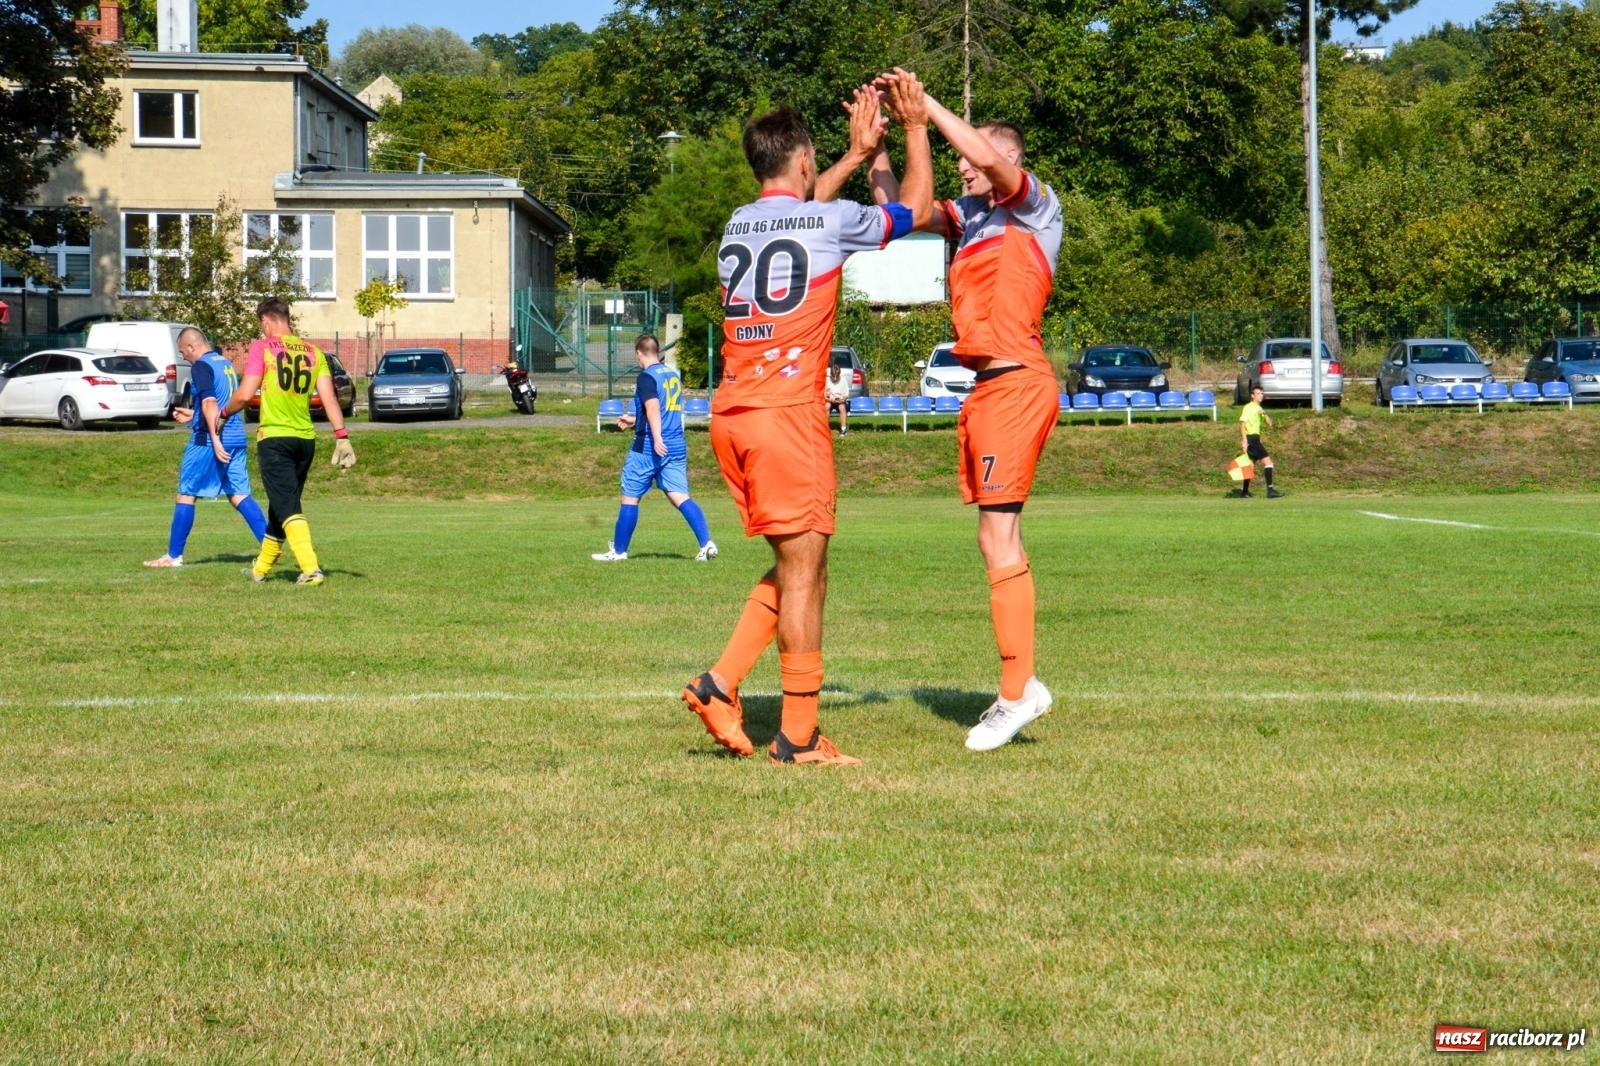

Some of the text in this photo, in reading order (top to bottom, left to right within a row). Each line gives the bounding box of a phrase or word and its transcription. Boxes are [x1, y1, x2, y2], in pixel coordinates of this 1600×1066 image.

[752, 220, 768, 234] 46
[769, 216, 825, 232] ZAWADA
[718, 238, 810, 319] 20
[736, 324, 774, 341] GOJNY
[276, 351, 312, 394] 66
[663, 376, 682, 411] 12
[982, 455, 996, 483] 7
